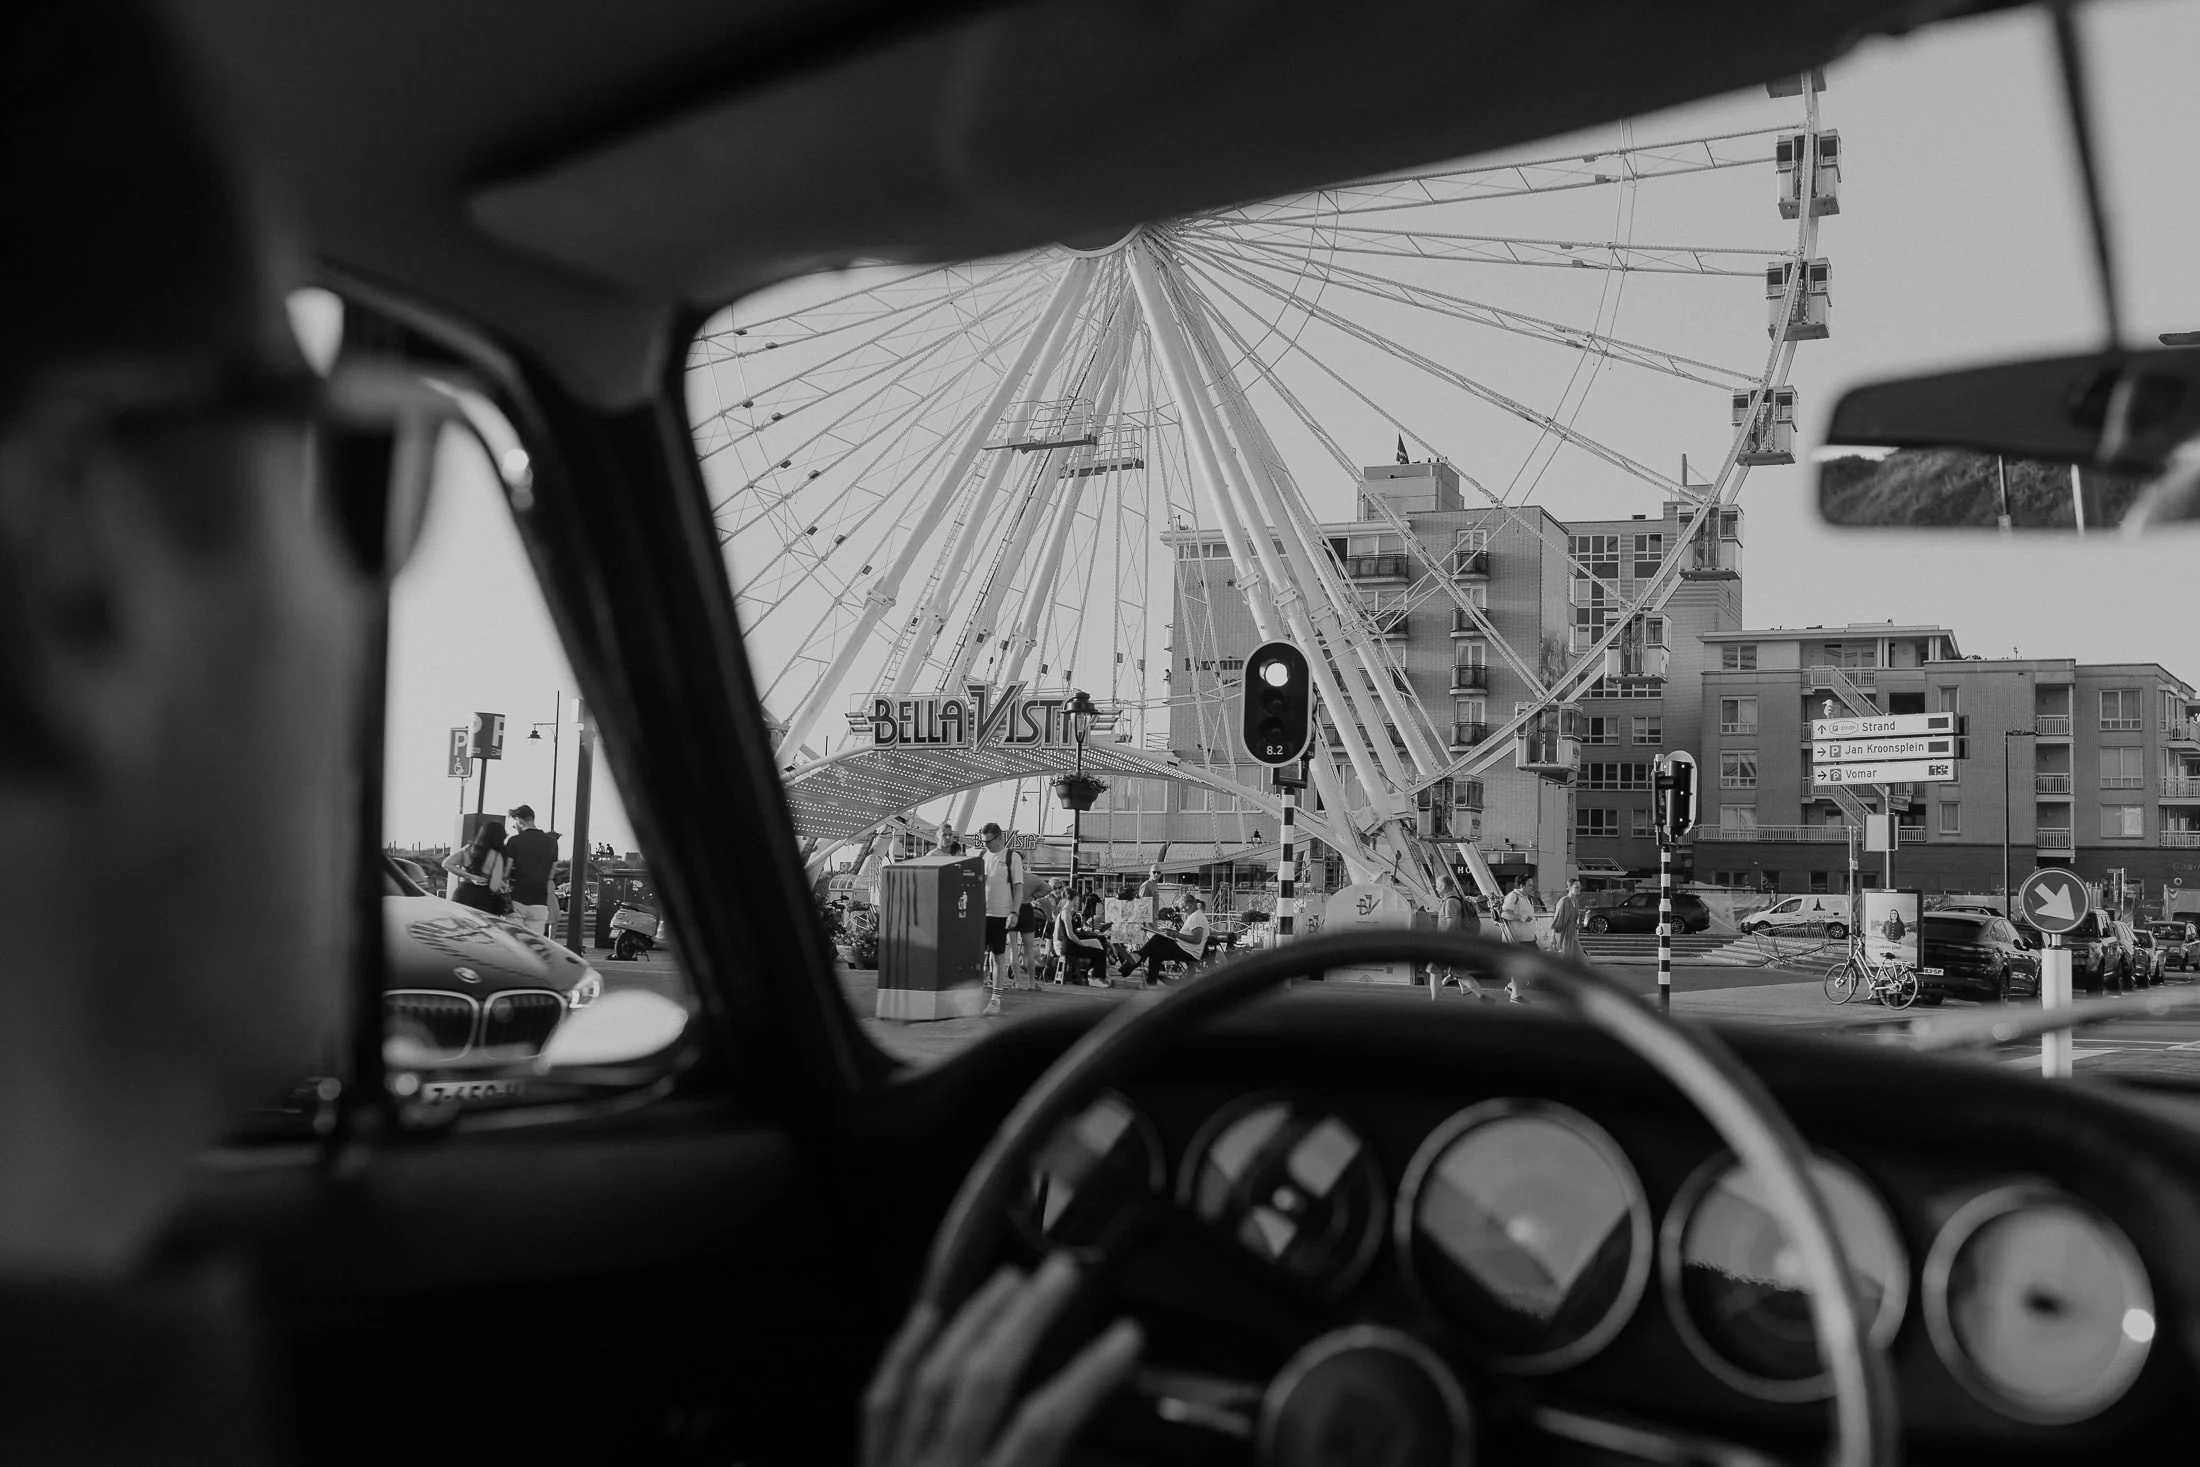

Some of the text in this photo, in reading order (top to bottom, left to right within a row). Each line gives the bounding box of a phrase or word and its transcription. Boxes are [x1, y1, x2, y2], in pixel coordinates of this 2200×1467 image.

[869, 697, 967, 749] BELLA
[1862, 721, 1896, 732] Strand
[453, 731, 468, 756] P
[1266, 745, 1284, 755] 8.2
[1845, 745, 1863, 755] Jan
[1867, 742, 1924, 754] Kroonsplein
[1845, 769, 1877, 779] Vomar
[1002, 830, 1037, 849] VISTA
